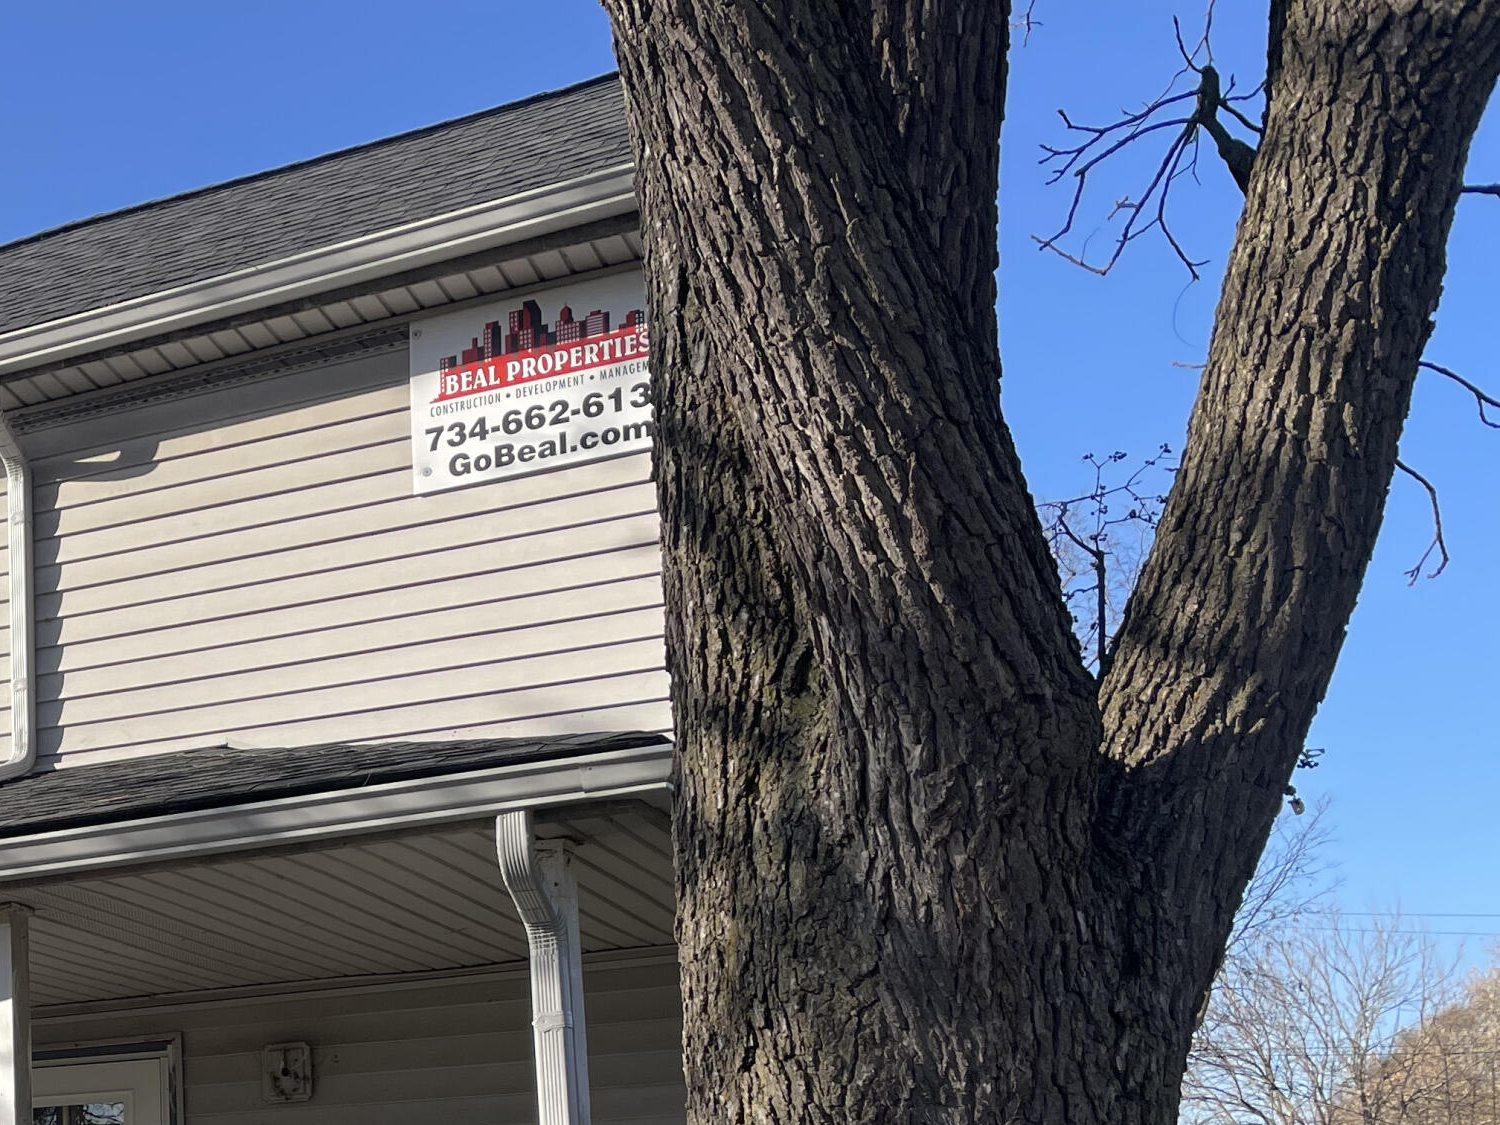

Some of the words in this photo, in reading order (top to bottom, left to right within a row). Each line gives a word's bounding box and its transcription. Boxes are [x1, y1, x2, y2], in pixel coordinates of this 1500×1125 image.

[430, 393, 501, 418] CONSTRUCTION
[515, 374, 585, 399] DEVELOPMENT
[599, 360, 648, 381] MANAGEM
[445, 365, 500, 395] BEAL
[506, 331, 649, 382] PROPERTIES
[425, 382, 651, 452] 734-662-613
[448, 420, 653, 477] GoBeal.com
